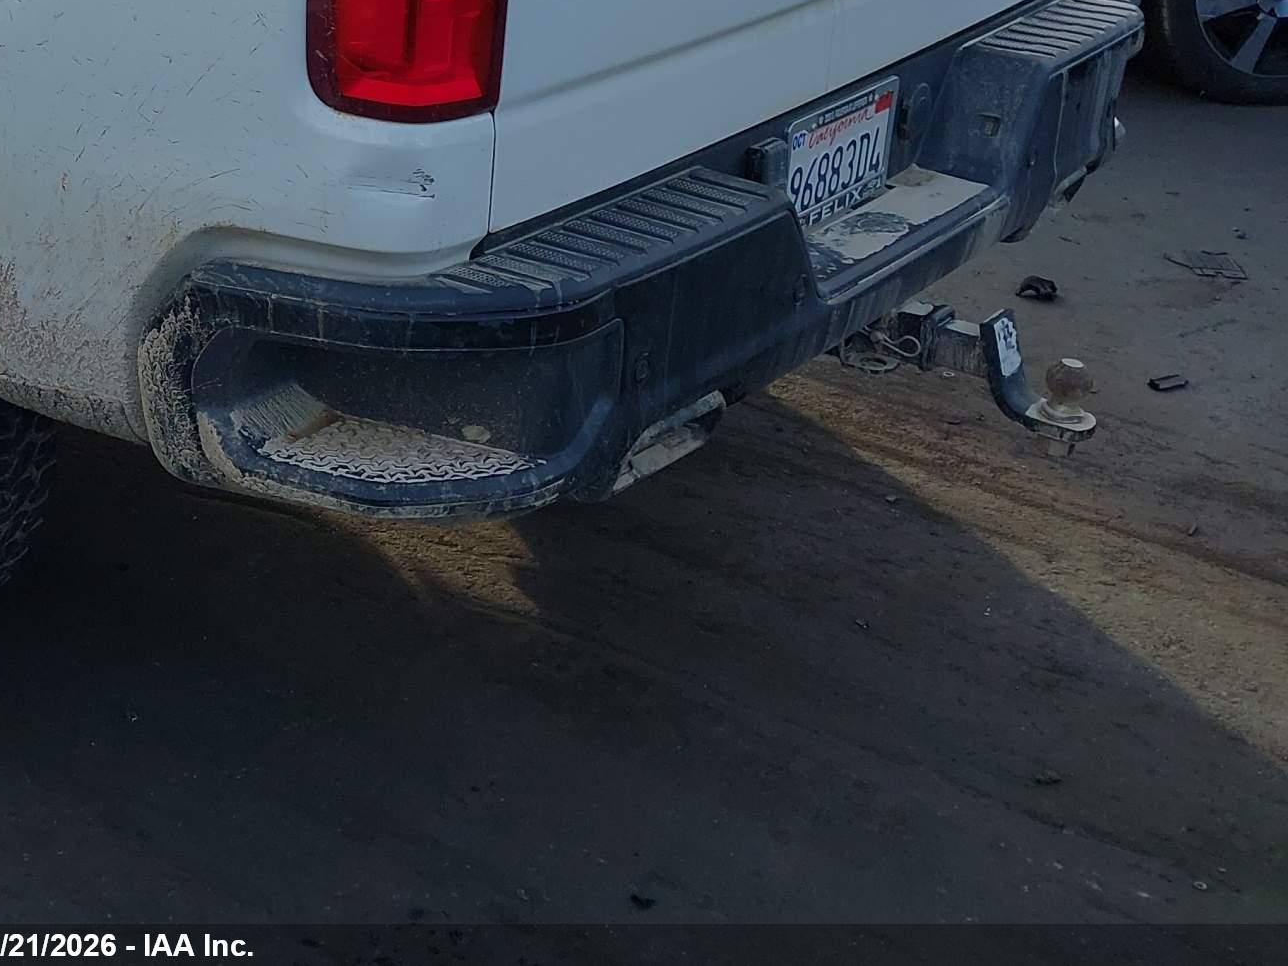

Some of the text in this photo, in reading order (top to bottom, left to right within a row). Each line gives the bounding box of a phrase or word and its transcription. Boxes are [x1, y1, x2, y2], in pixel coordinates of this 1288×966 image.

[792, 133, 806, 150] OCT
[808, 109, 874, 149] California
[790, 127, 882, 211] 96883D4
[808, 186, 863, 226] FELIX
